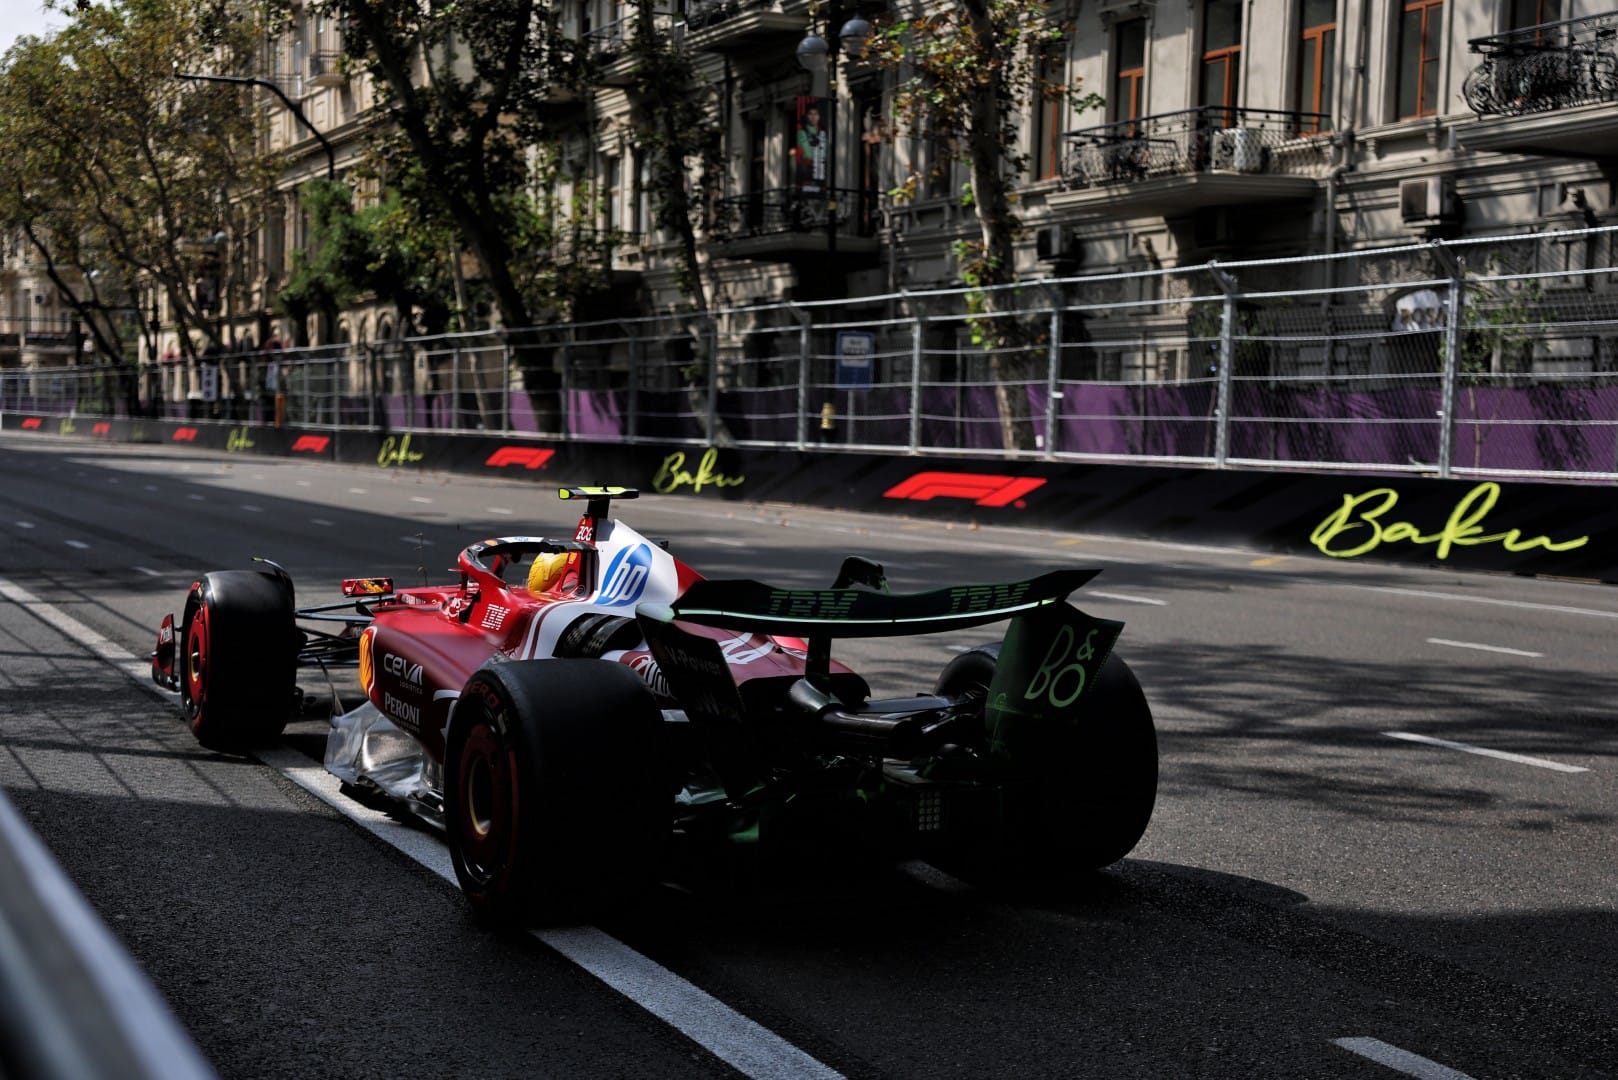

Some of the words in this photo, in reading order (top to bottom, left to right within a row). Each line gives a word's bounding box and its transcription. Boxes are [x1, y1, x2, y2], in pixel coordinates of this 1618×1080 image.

[484, 446, 555, 471] F1
[654, 448, 745, 493] Baku
[883, 471, 1047, 509] F1
[1309, 481, 1589, 560] Baku
[597, 543, 653, 607] hp
[768, 590, 859, 617] IBM
[948, 583, 1031, 611] IBM
[384, 690, 421, 726] PERONI
